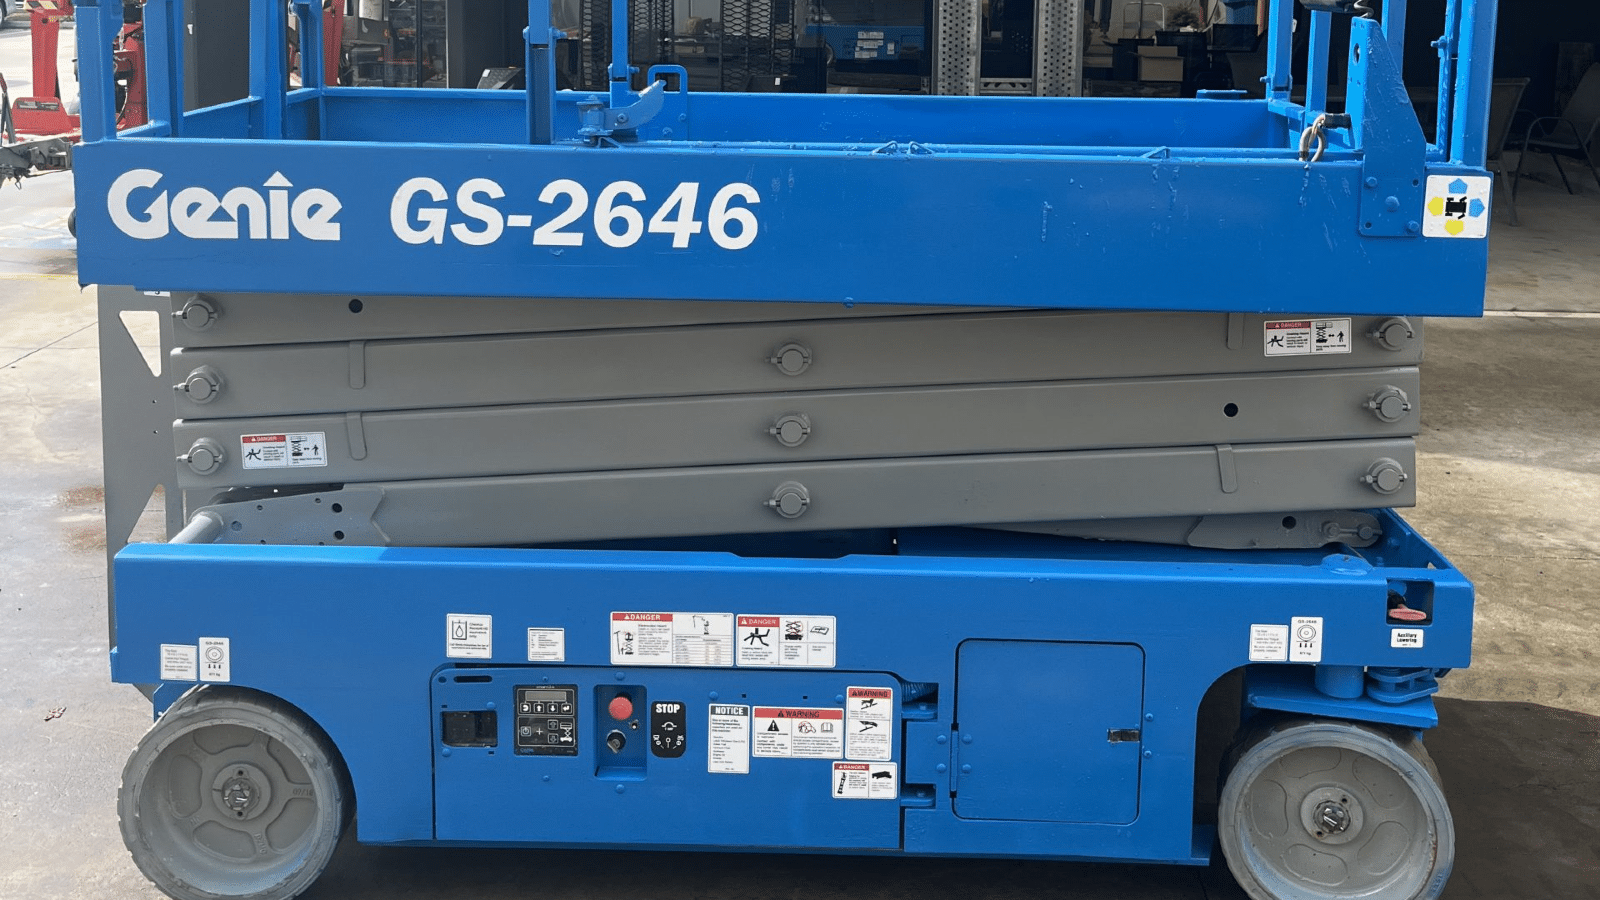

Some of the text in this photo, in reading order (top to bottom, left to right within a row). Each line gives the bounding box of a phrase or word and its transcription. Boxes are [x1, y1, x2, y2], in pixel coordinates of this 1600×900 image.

[107, 168, 762, 250] Genie GS-2646
[630, 613, 661, 621] DANGER
[655, 703, 681, 713] STOP
[715, 706, 744, 715] NOTICE
[786, 710, 820, 718] WARNING
